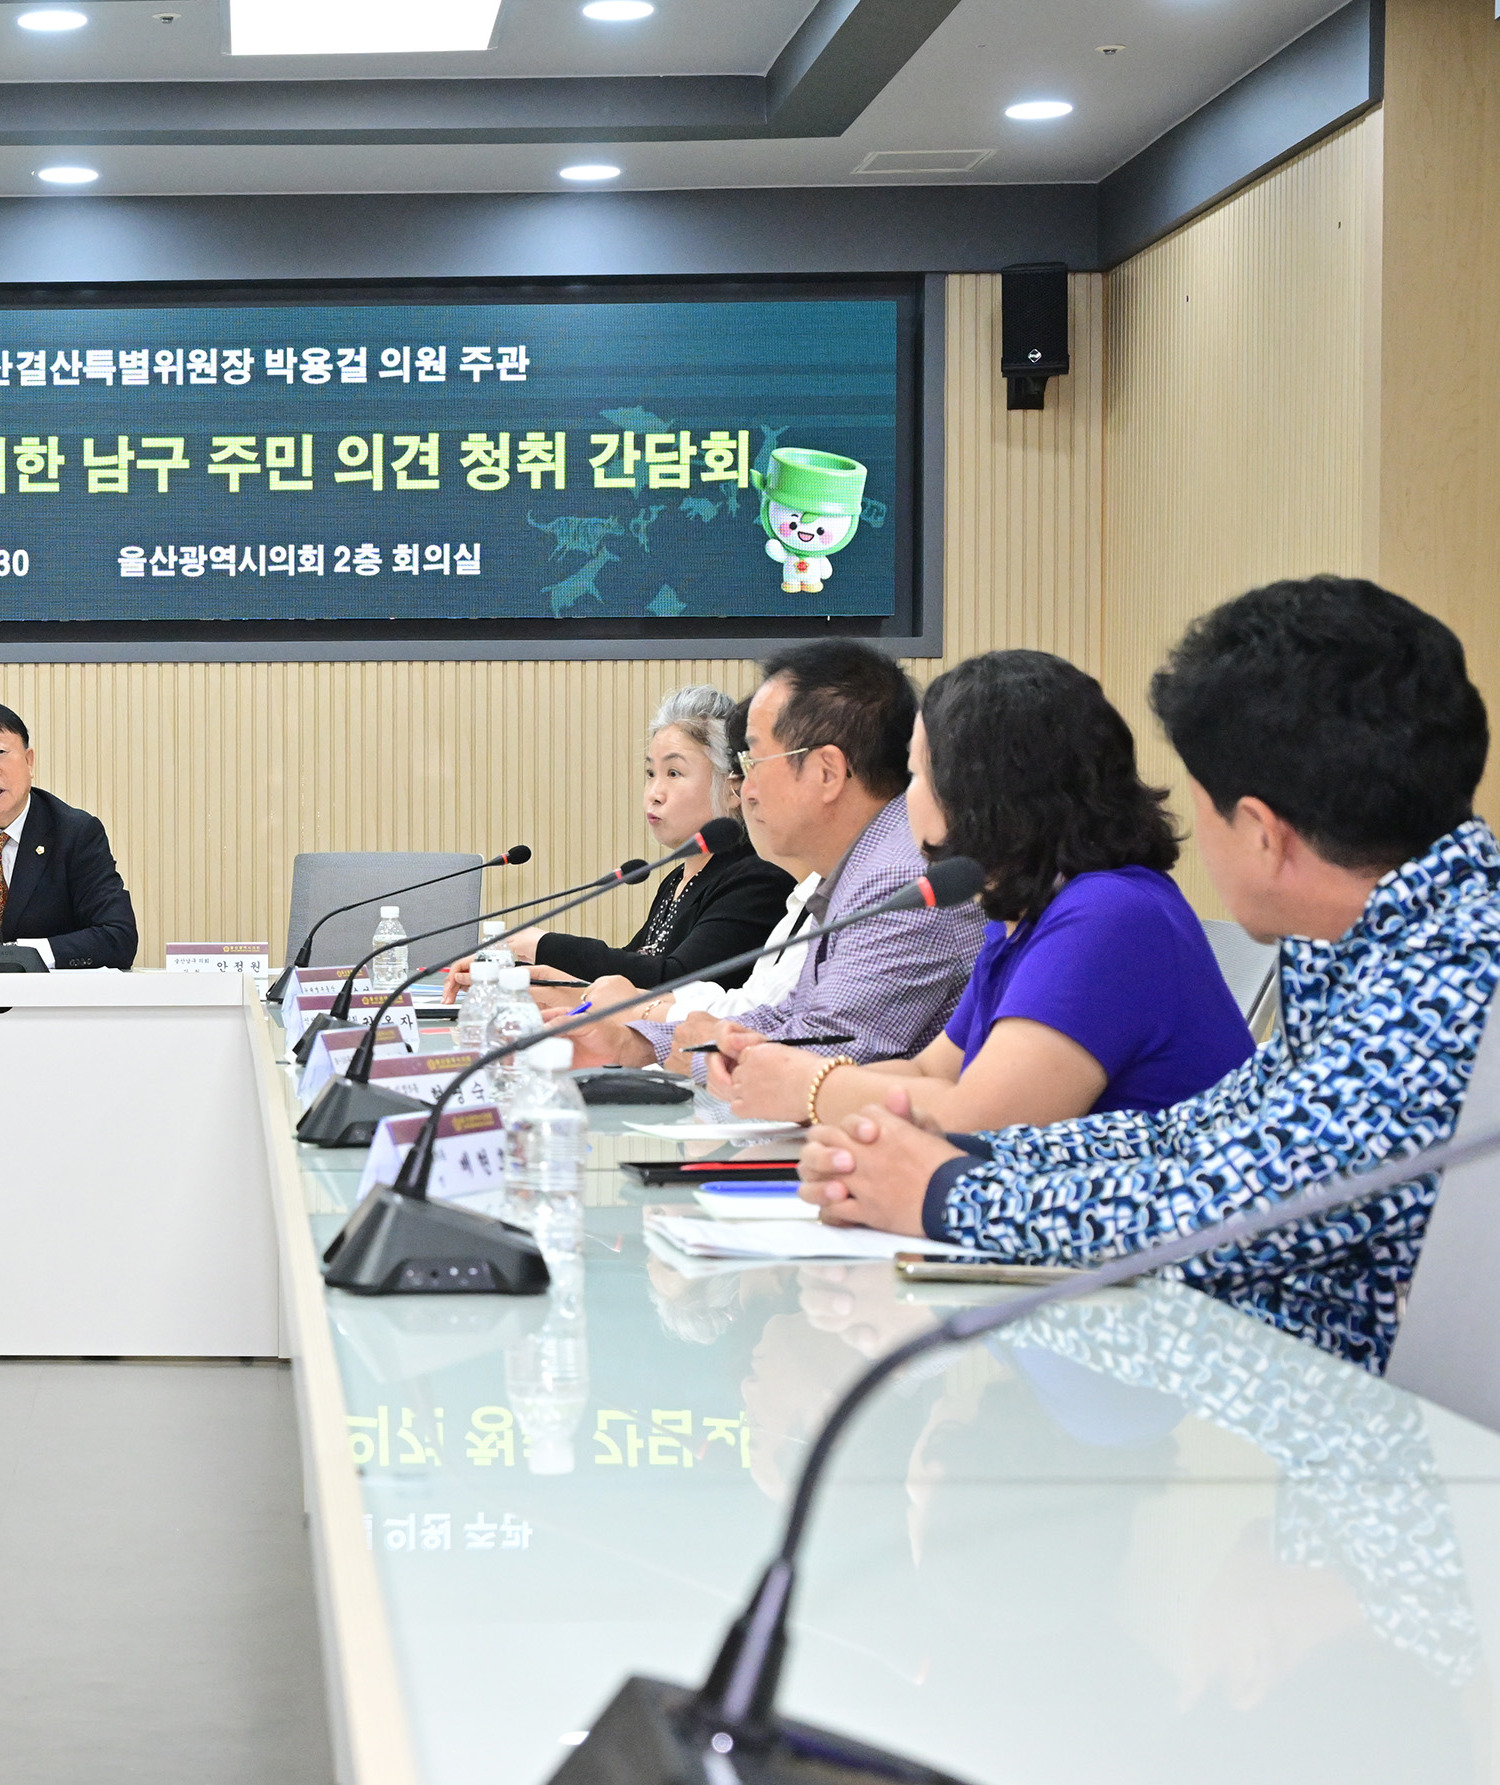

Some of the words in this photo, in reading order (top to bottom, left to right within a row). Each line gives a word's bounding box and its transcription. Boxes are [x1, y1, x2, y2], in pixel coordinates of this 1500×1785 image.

[265, 346, 367, 385] 박용걸
[378, 345, 447, 383] 의원
[459, 345, 530, 383] 주관
[83, 435, 190, 494] 남구
[207, 433, 313, 493] 주민
[334, 432, 440, 491] 의견
[459, 431, 566, 491] 청취
[589, 430, 751, 489] 간담회
[117, 544, 324, 578] 울산광역시의회
[334, 543, 383, 576] 2층
[392, 542, 481, 576] 회의실
